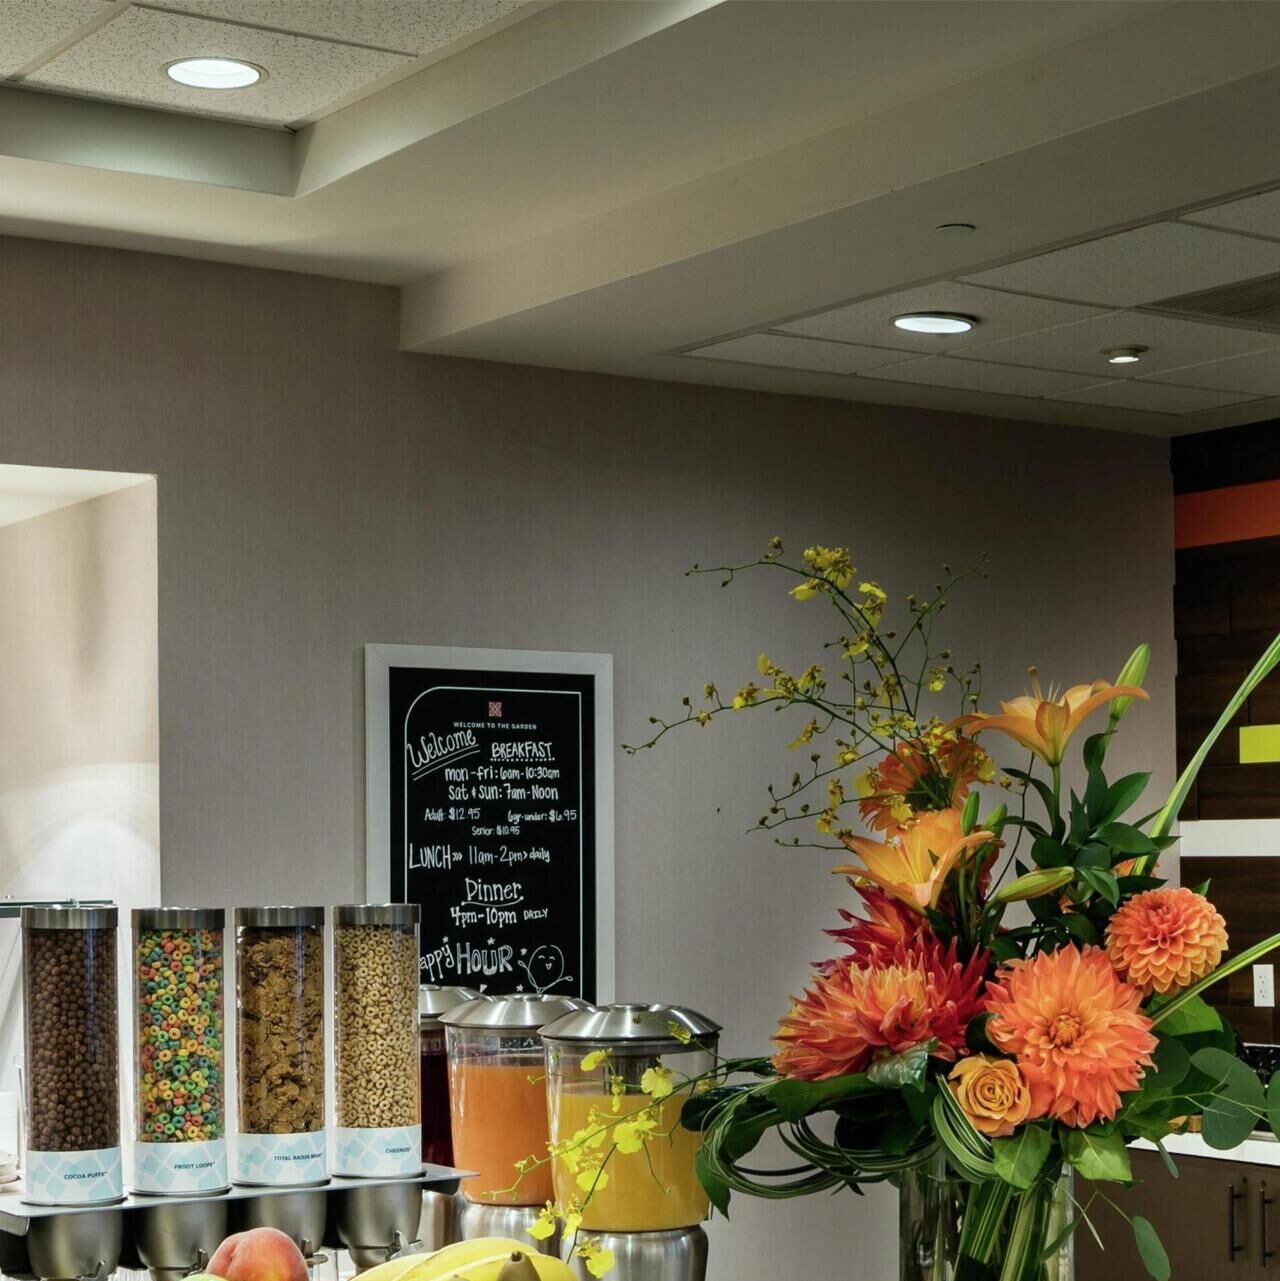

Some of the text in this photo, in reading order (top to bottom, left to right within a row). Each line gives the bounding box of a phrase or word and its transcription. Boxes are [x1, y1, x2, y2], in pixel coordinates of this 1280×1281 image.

[453, 721, 485, 729] WELCOME
[407, 729, 477, 768] Welcome
[491, 741, 552, 759] BREAKFAST
[448, 807, 481, 821] $12.95
[409, 842, 452, 870] LUNCH
[529, 847, 551, 863] daily
[523, 908, 549, 921] DAILY
[420, 942, 513, 982] appy HOUR
